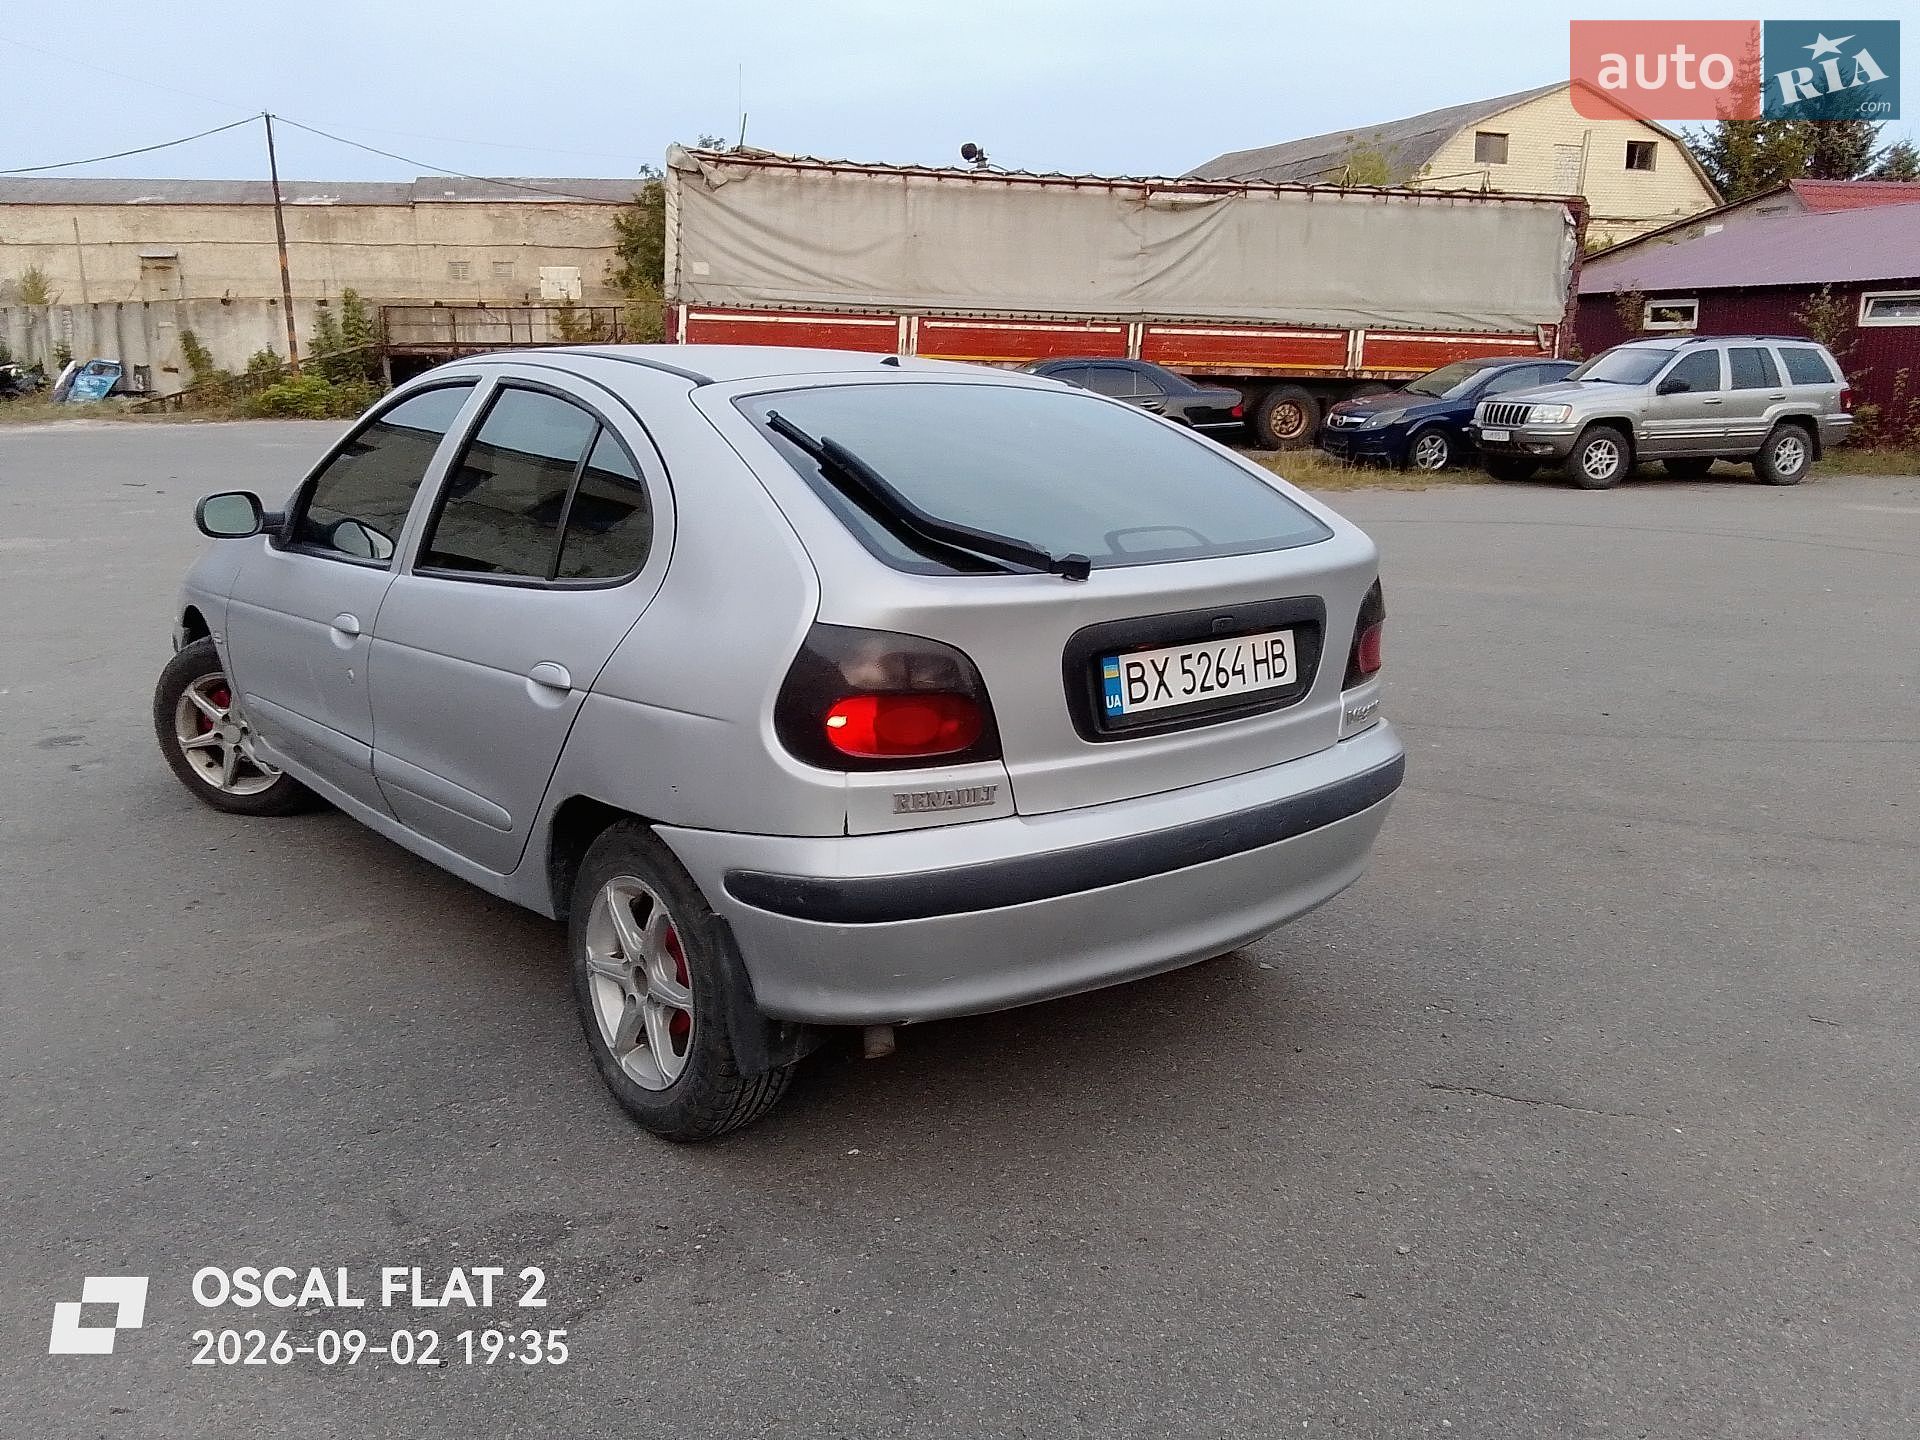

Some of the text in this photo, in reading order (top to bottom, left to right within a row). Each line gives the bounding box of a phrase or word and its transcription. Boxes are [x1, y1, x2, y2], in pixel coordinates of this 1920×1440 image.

[1125, 638, 1287, 705] BX 5264 HB
[1106, 695, 1122, 709] UA
[893, 784, 997, 814] RENAULT
